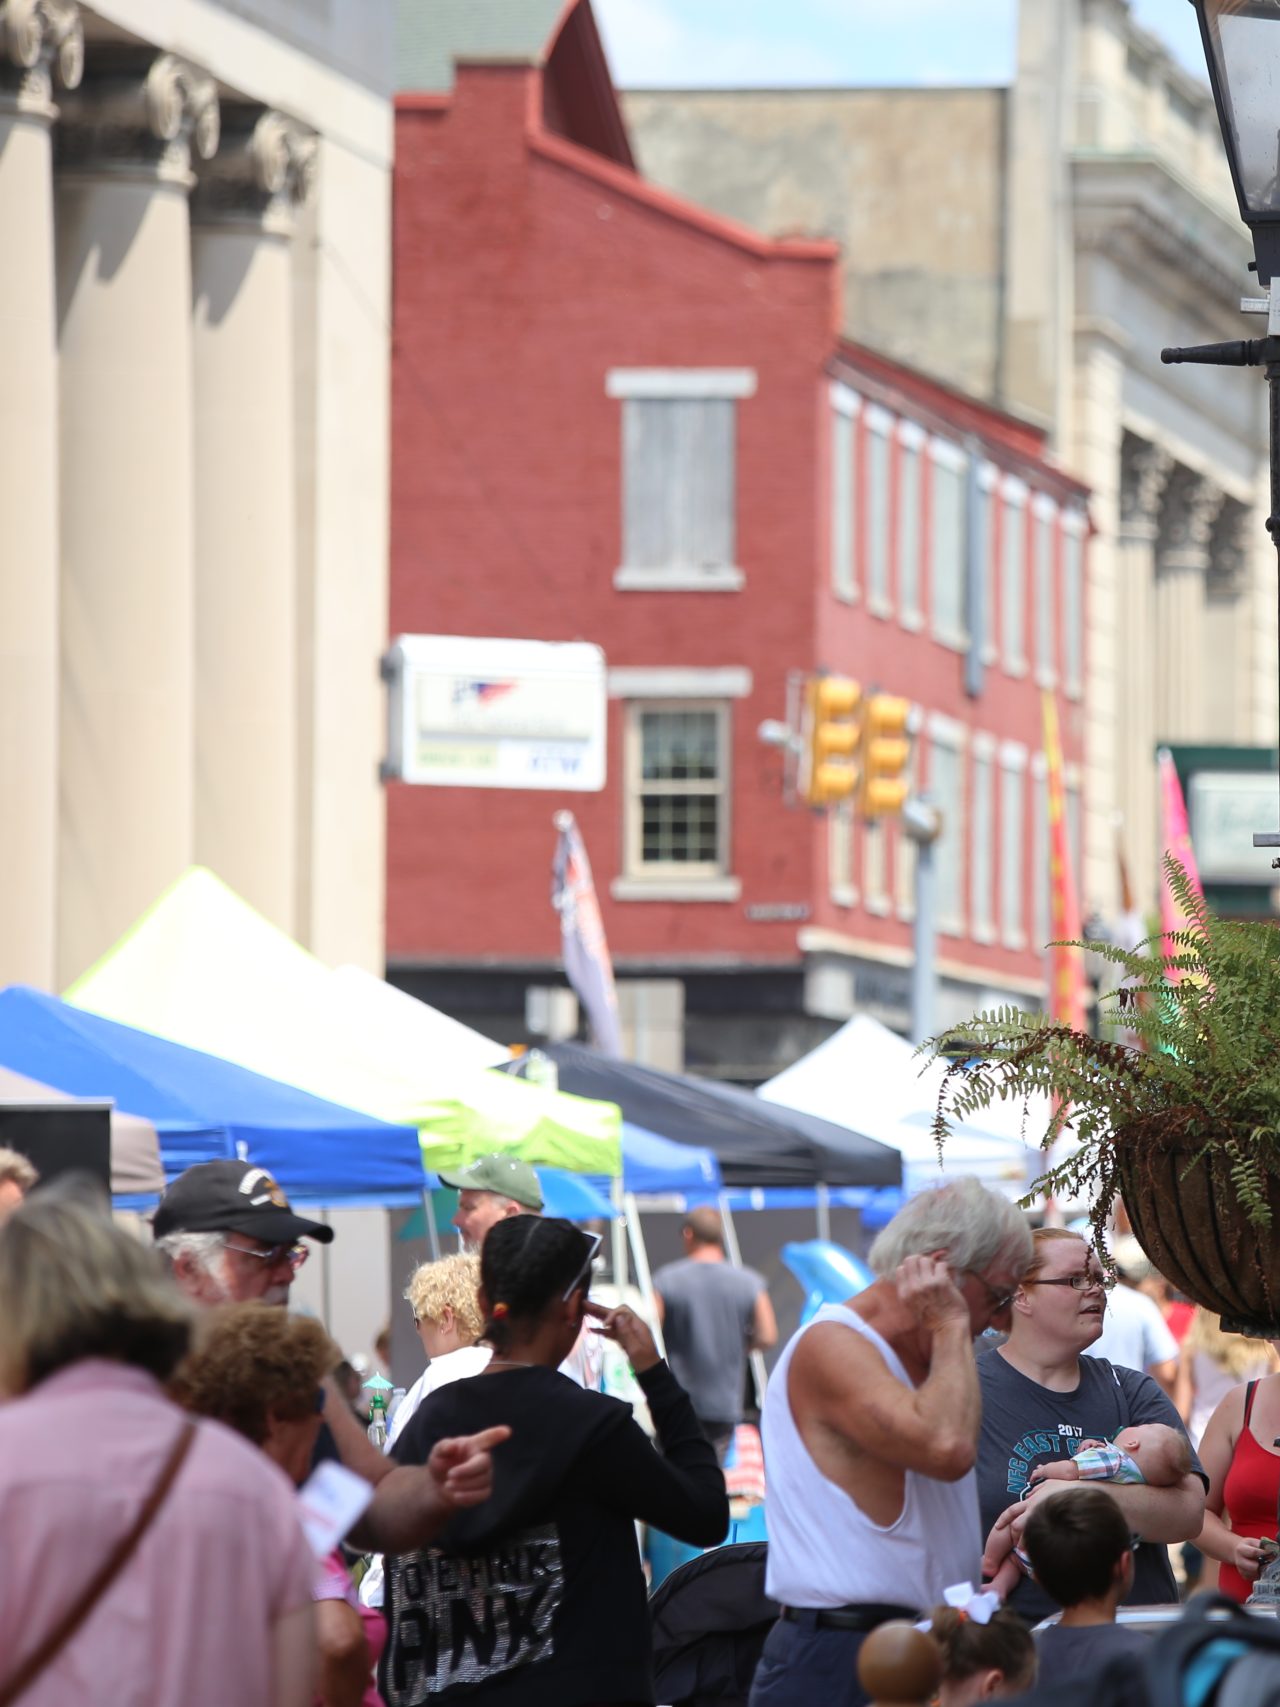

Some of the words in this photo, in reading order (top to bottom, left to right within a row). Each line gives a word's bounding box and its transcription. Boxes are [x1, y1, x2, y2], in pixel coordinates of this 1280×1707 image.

[1057, 1423, 1083, 1438] 2017
[1013, 1433, 1061, 1462] EAST
[1007, 1457, 1029, 1494] NFC
